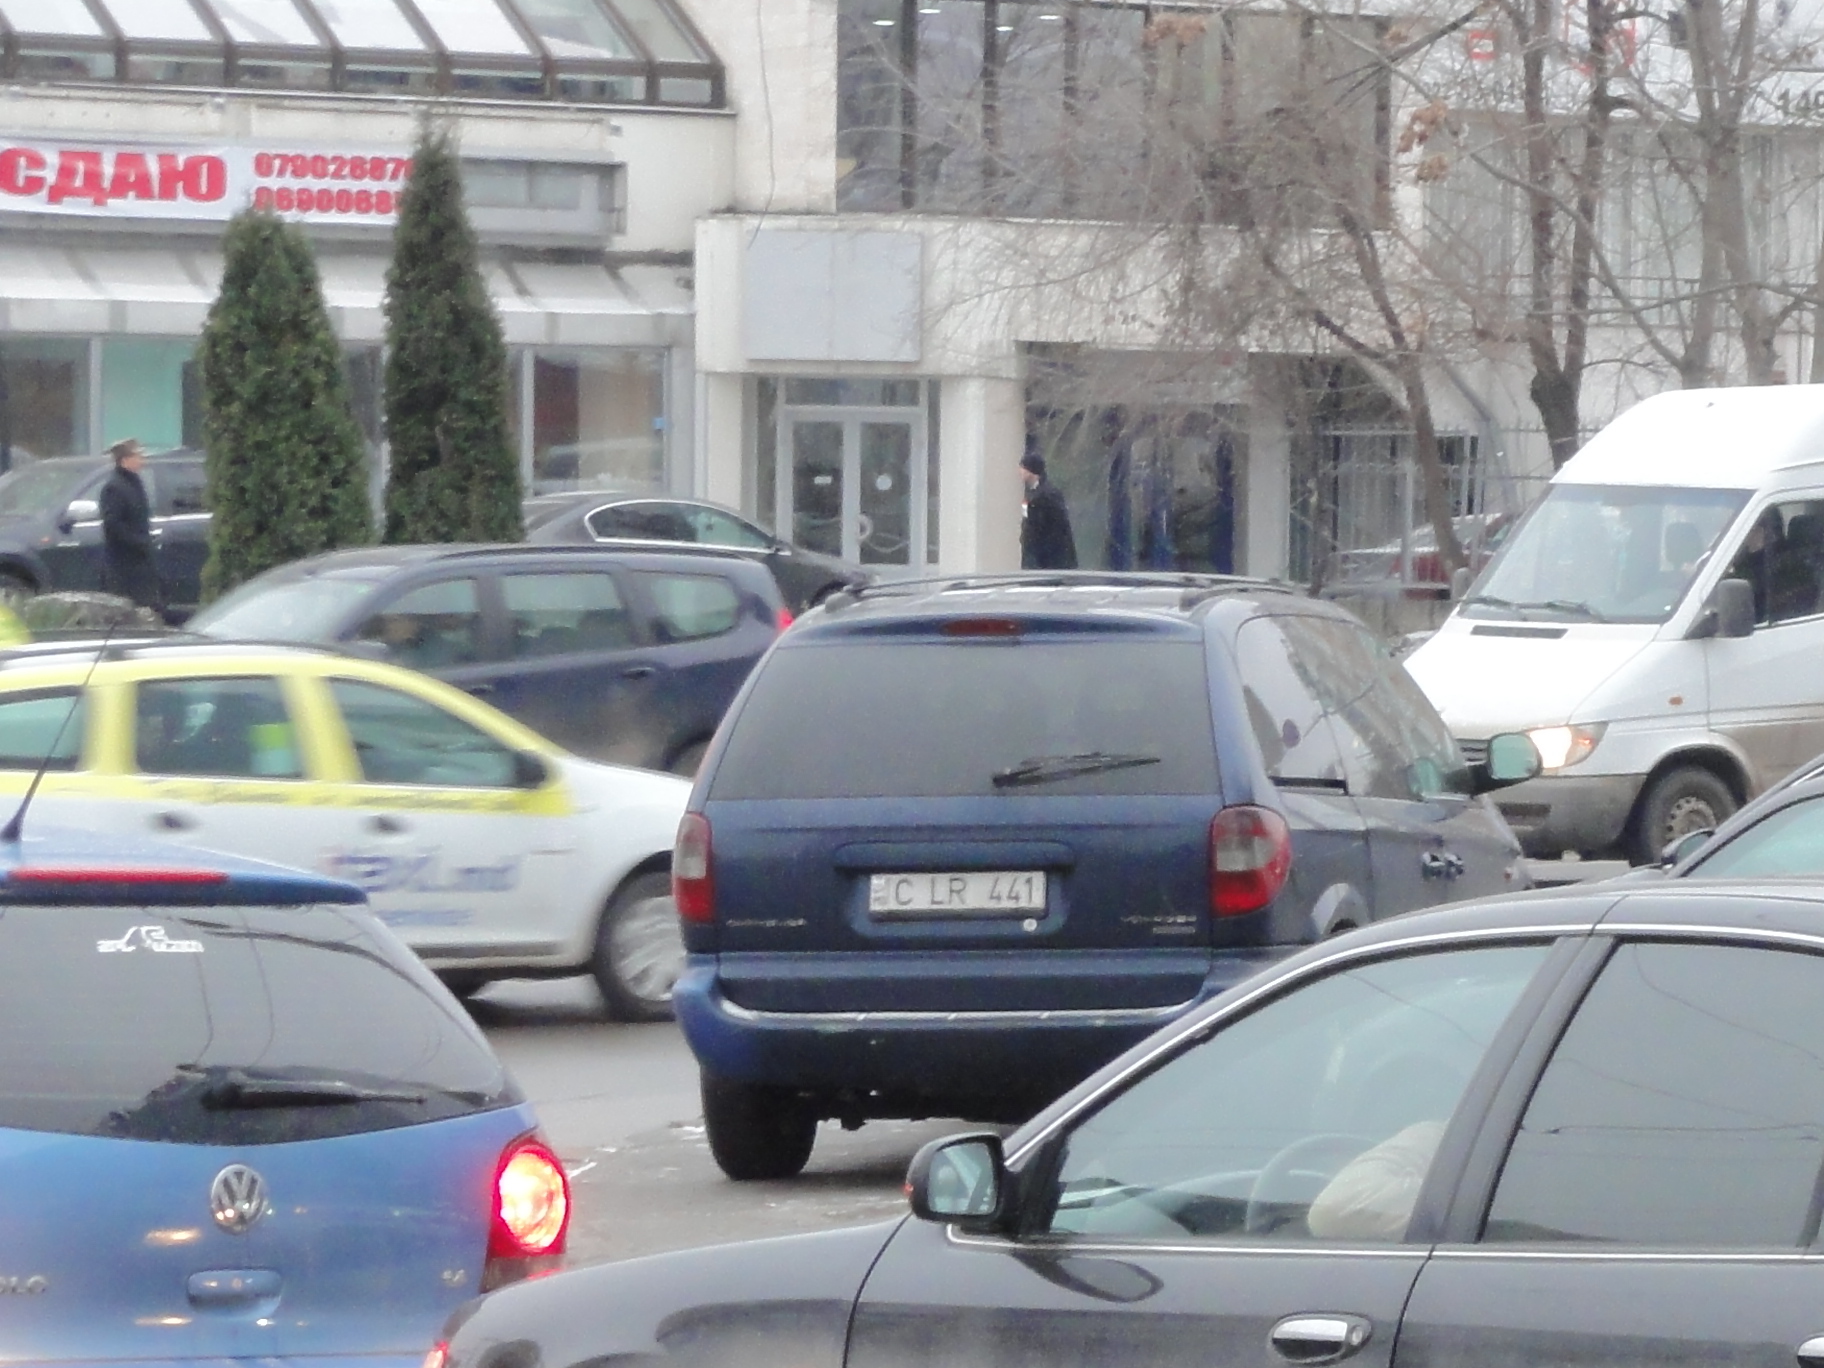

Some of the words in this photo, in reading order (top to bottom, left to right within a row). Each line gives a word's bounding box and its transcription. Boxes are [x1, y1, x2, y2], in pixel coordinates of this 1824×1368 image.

[0, 147, 227, 206] СДАЮ
[930, 877, 968, 906] LR
[989, 875, 1034, 905] 441
